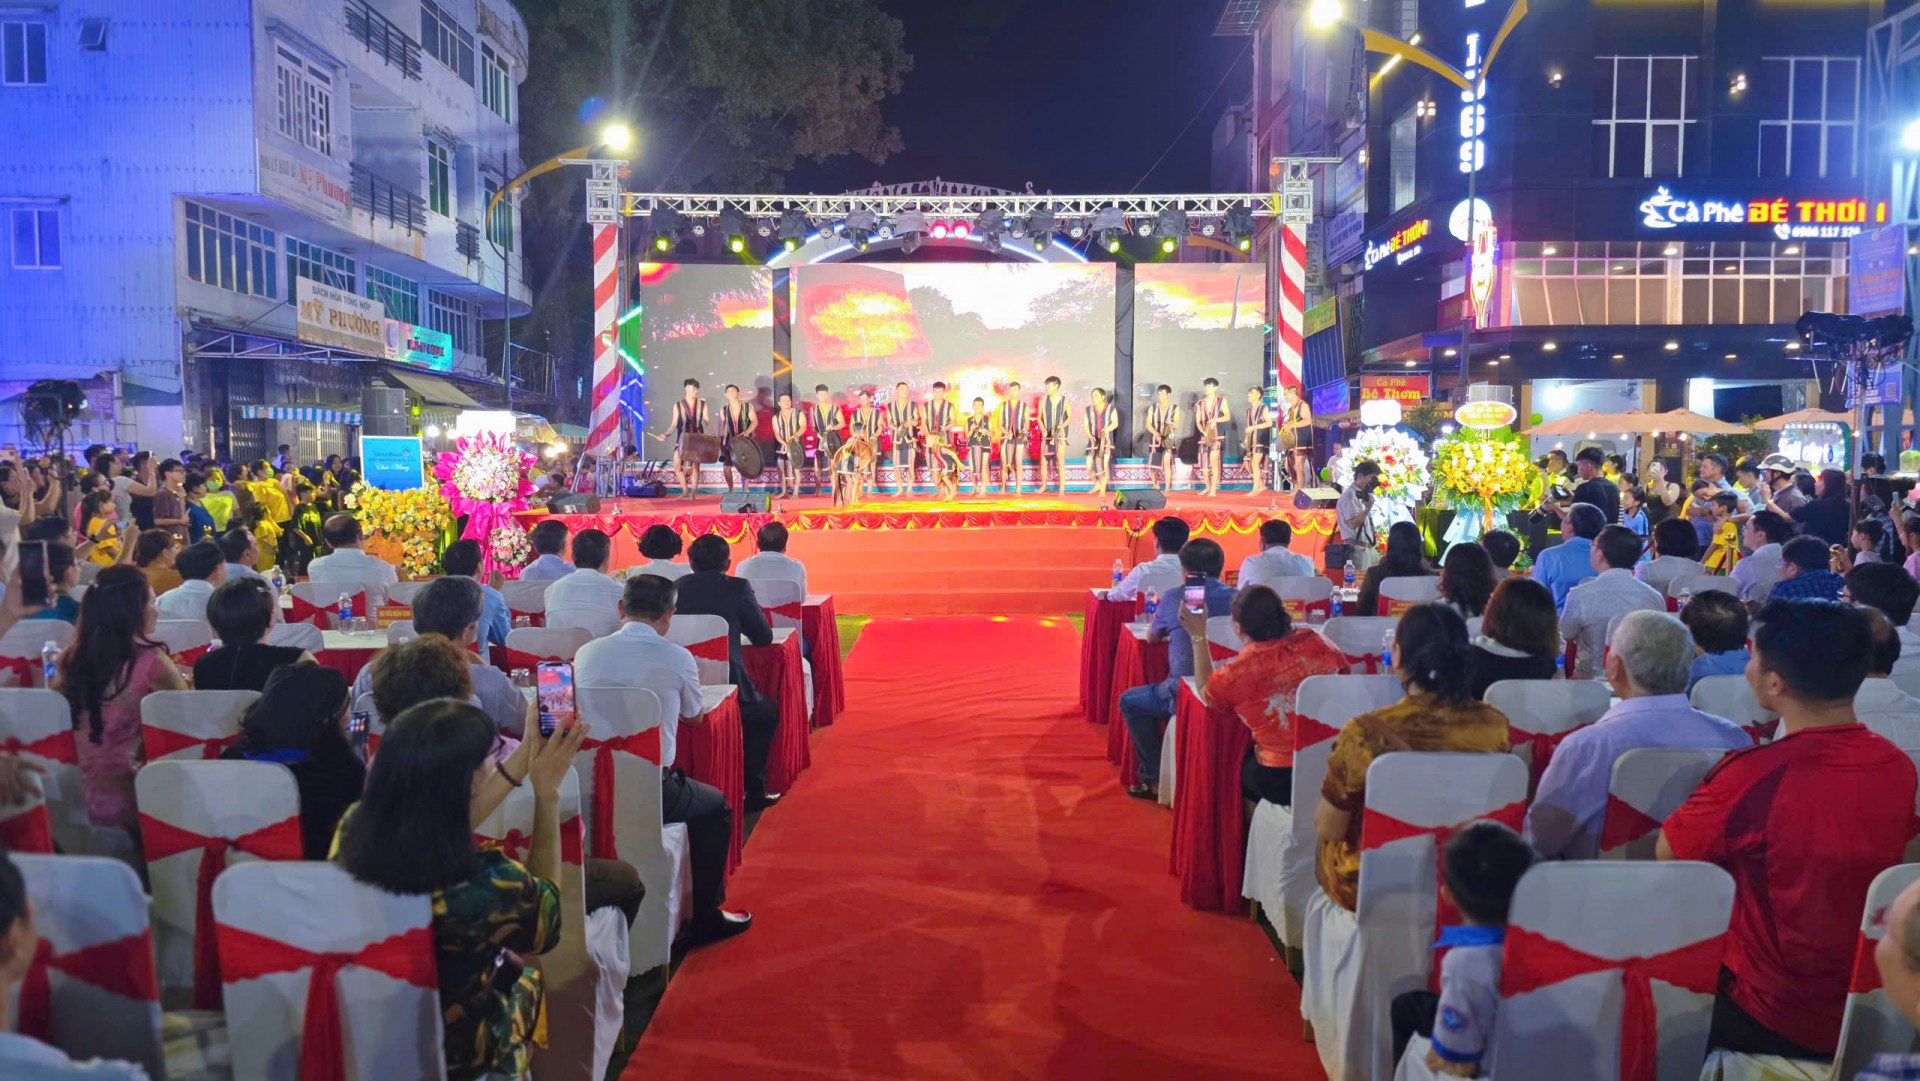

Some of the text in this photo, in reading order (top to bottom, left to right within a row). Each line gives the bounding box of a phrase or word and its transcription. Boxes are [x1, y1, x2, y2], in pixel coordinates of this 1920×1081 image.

[1703, 202, 1744, 223] Phê
[1748, 198, 1788, 223] BÉ
[300, 298, 323, 321] MỸ
[1361, 387, 1378, 400] Bé
[1383, 387, 1421, 400] Thơm
